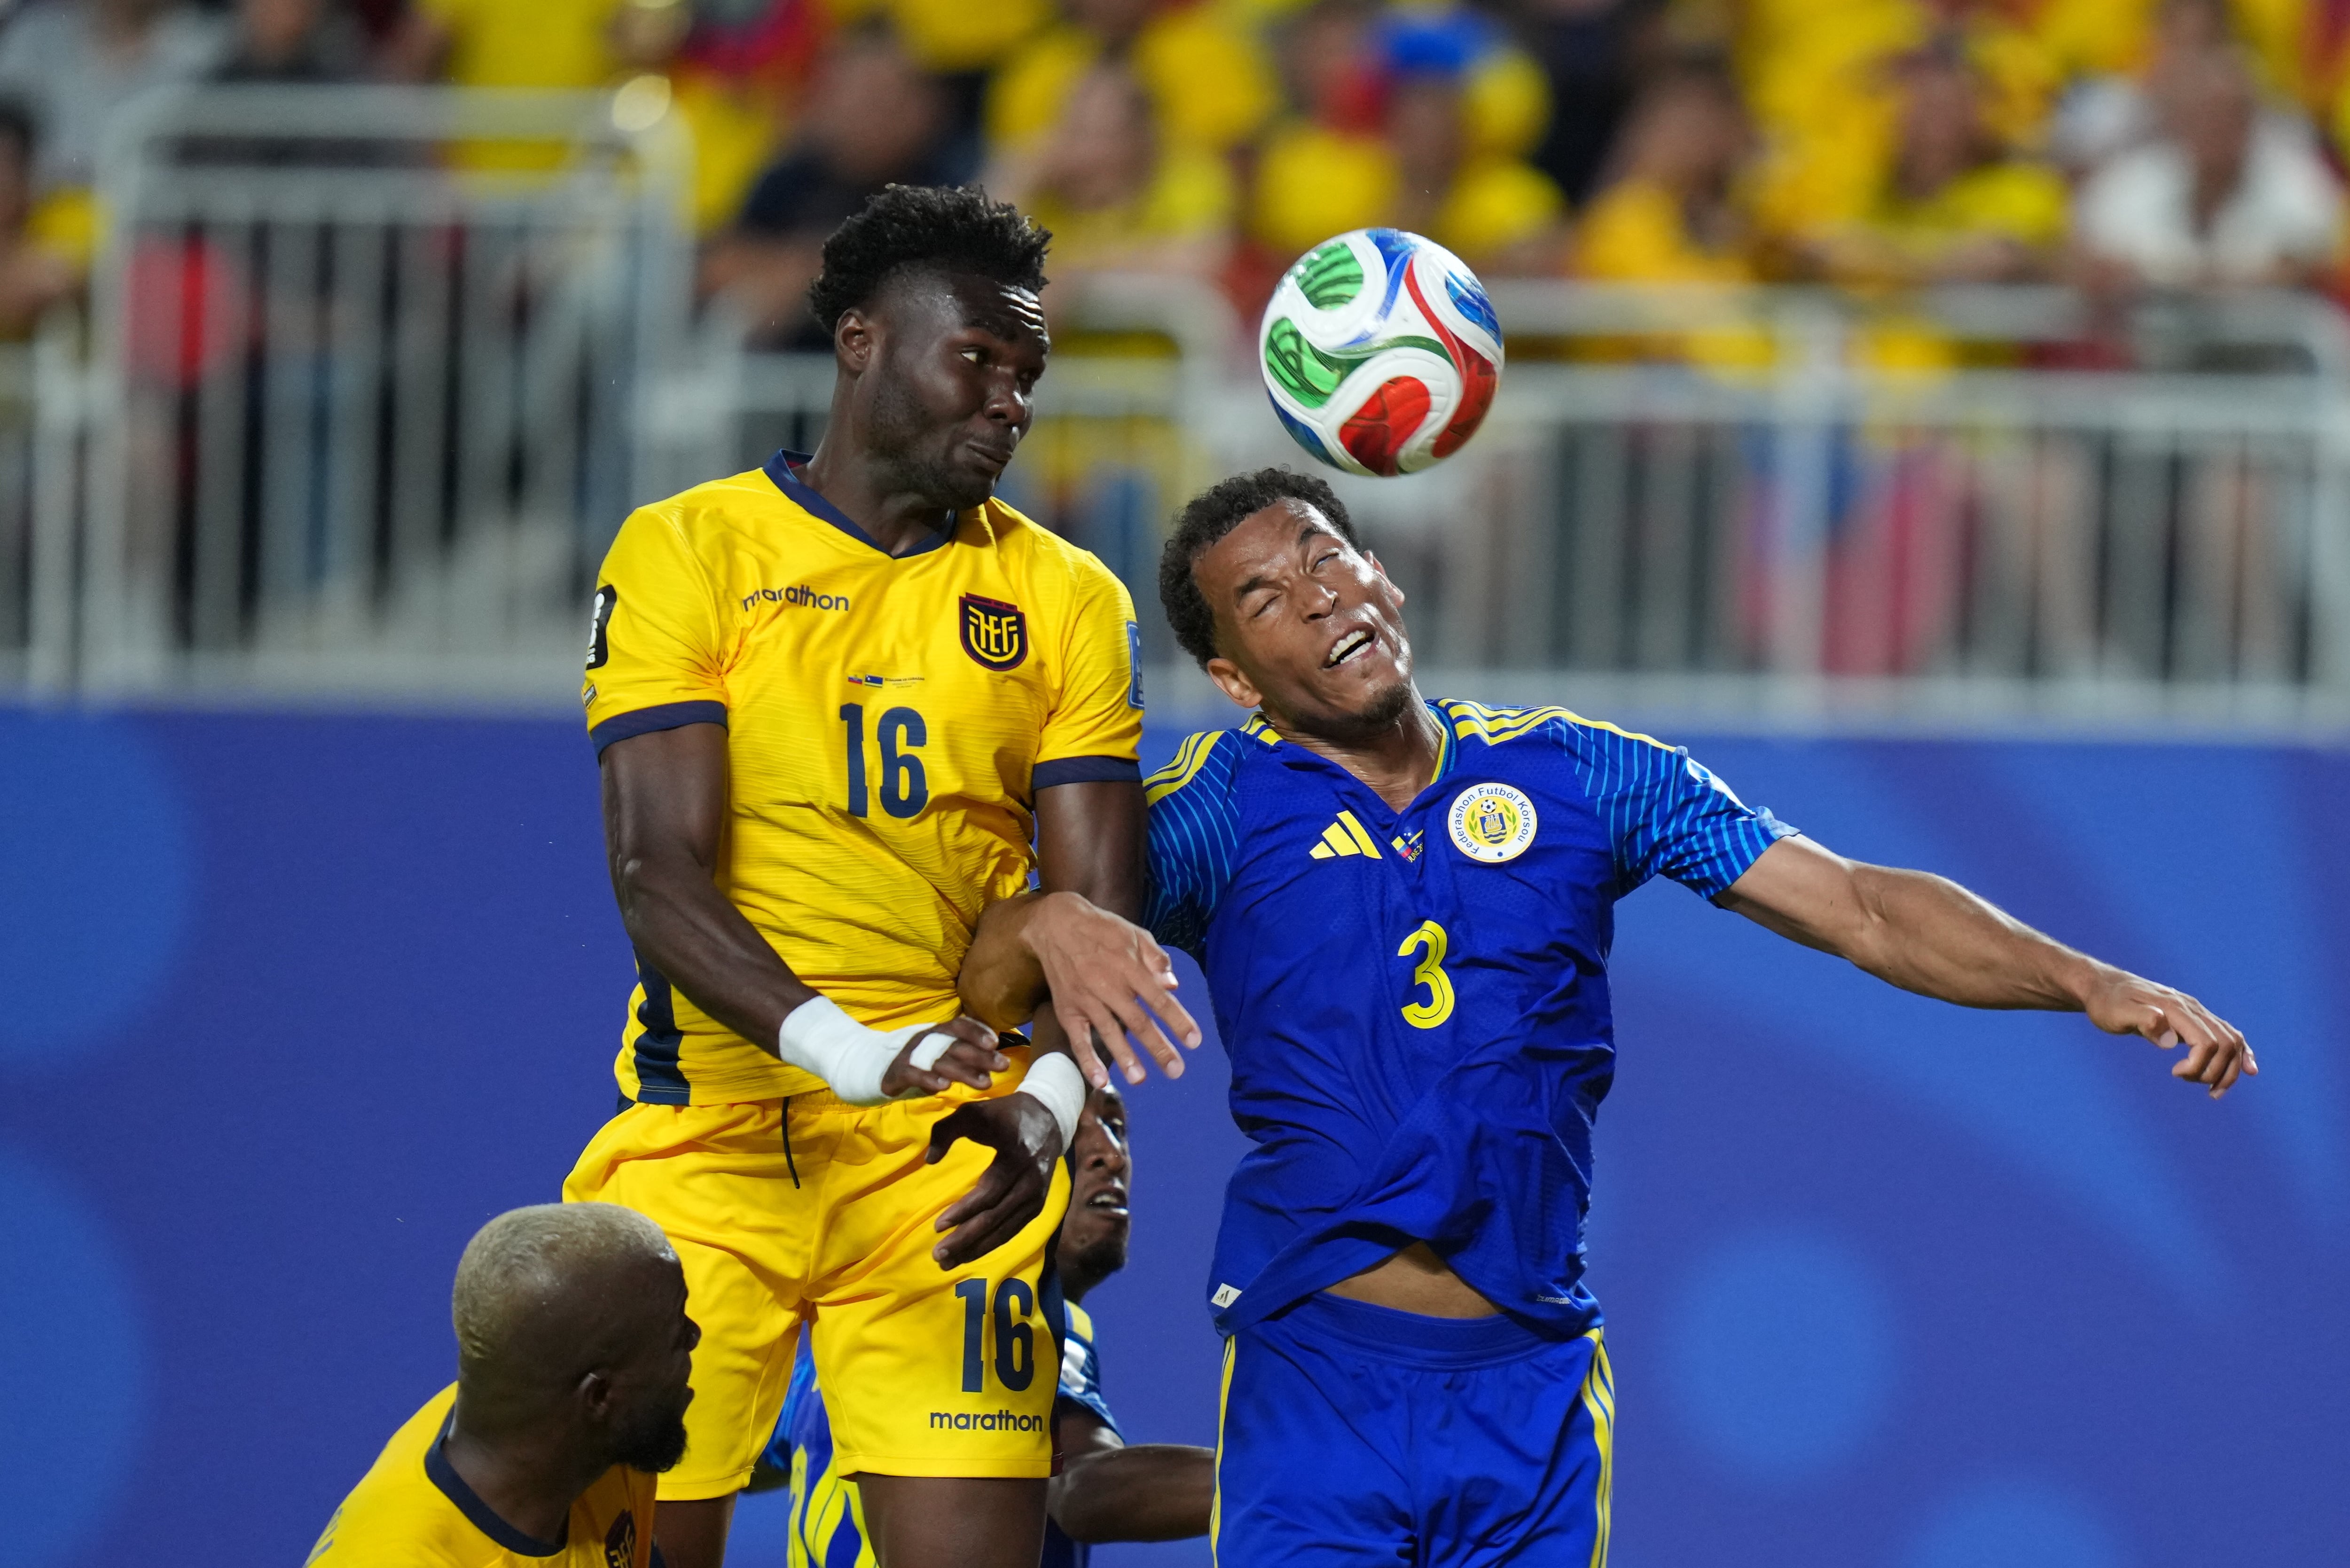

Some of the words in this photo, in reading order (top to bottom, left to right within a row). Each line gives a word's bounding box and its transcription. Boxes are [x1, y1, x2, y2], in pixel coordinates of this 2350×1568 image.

[743, 583, 849, 612] marathon
[840, 702, 929, 818] 16
[1455, 793, 1480, 855] Federashon
[1407, 848, 1420, 863] JUNE
[1397, 920, 1455, 1029] 3
[955, 1277, 1034, 1393] 16
[930, 1410, 1043, 1432] marathon
